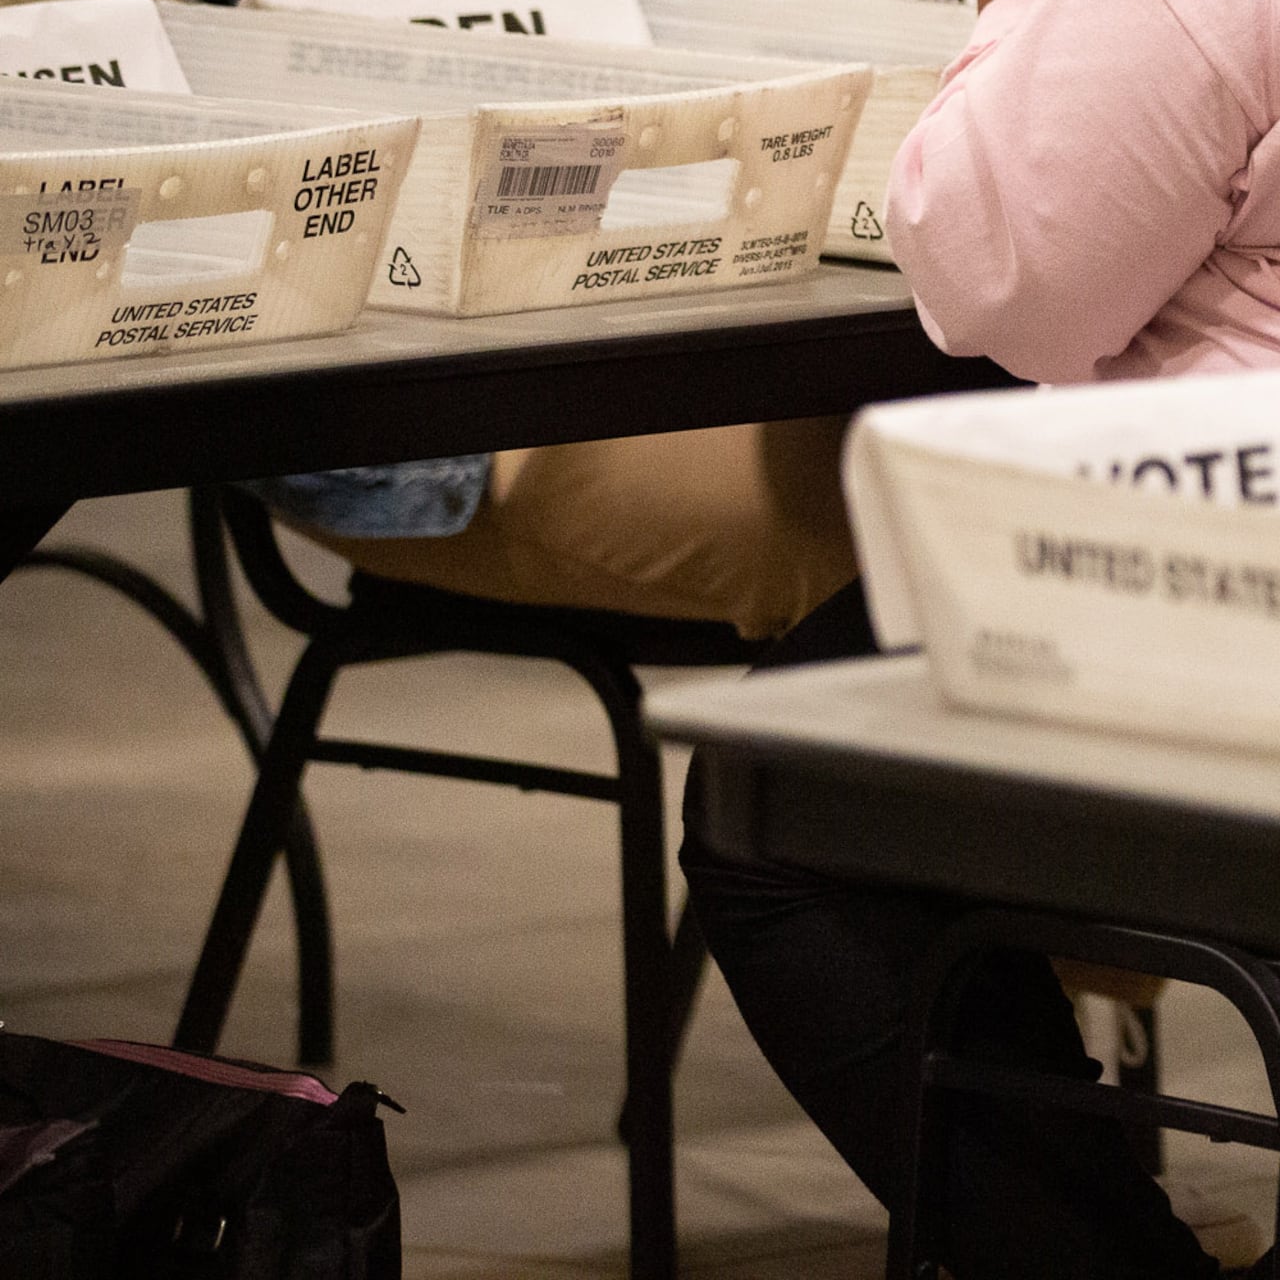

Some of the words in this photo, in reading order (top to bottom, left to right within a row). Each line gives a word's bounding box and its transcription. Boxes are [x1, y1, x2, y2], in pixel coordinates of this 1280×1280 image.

[761, 136, 789, 151] TARE
[790, 125, 834, 144] WEIGHT
[772, 148, 790, 163] 0.8
[792, 143, 815, 158] LBS
[301, 149, 381, 183] LABEL
[293, 178, 379, 212] OTHER
[488, 205, 510, 215] TUE
[23, 209, 95, 234] SM03
[303, 210, 356, 239] END
[586, 246, 652, 268] UNITED
[653, 236, 722, 260] STATES
[572, 268, 641, 291] POSTAL
[645, 258, 722, 281] SERVICE
[111, 301, 184, 324] UNITED
[184, 292, 258, 317] STATES
[95, 323, 170, 348] POSTAL
[174, 313, 259, 339] SERVICE
[1080, 445, 1278, 505] OTE
[1012, 530, 1155, 597] UNITED
